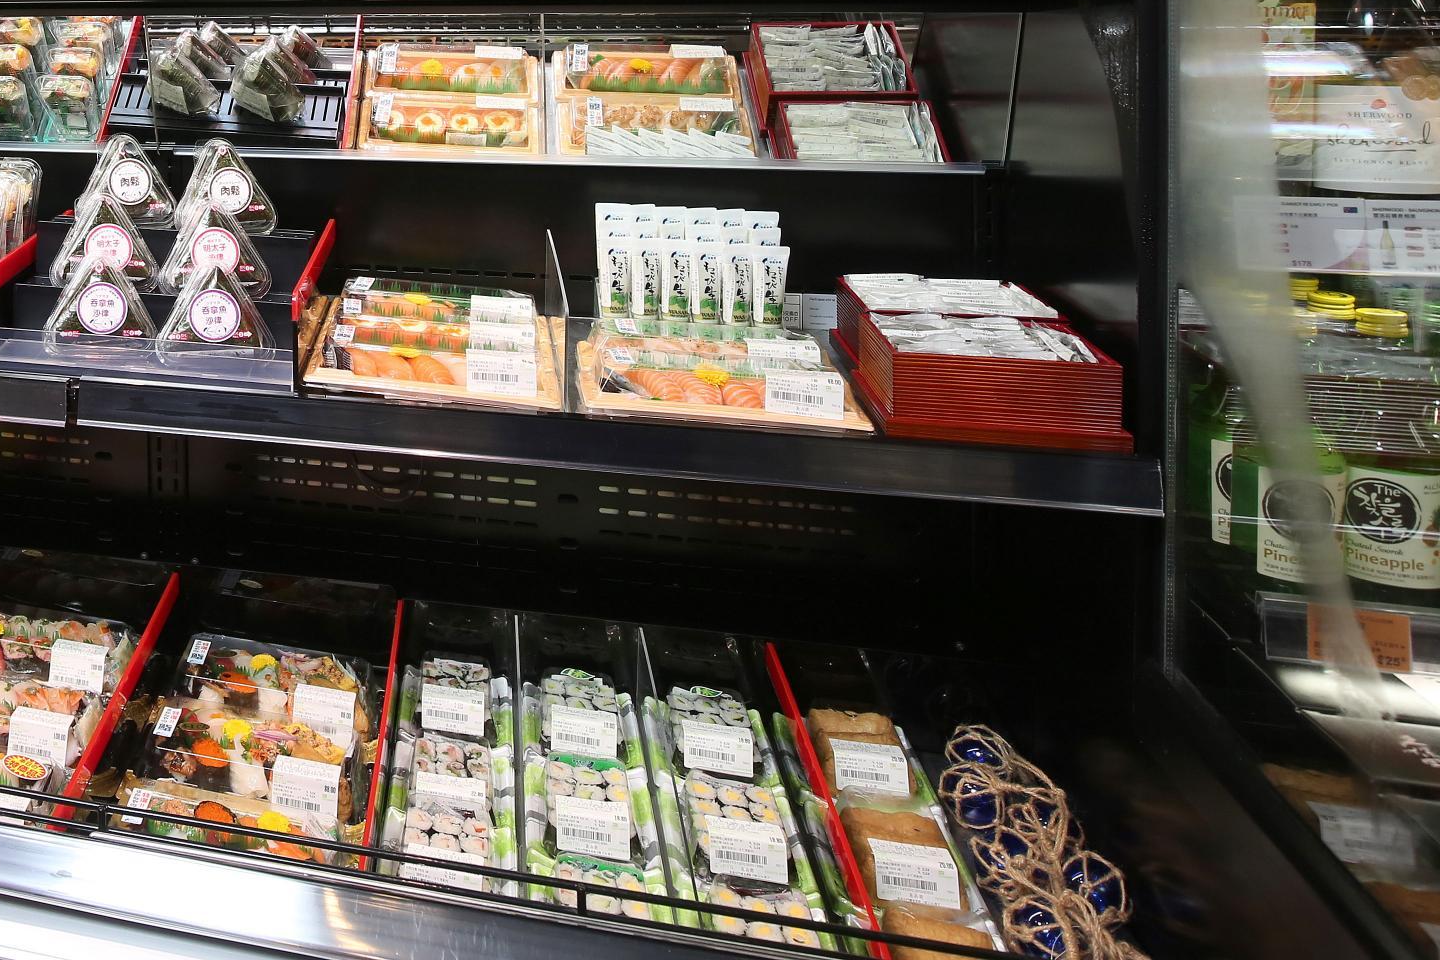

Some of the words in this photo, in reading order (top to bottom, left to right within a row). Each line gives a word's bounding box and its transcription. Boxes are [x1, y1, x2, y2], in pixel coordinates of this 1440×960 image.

[1348, 111, 1412, 119] SHERWOOD
[1374, 484, 1401, 496] The
[1346, 547, 1425, 572] Pineapple
